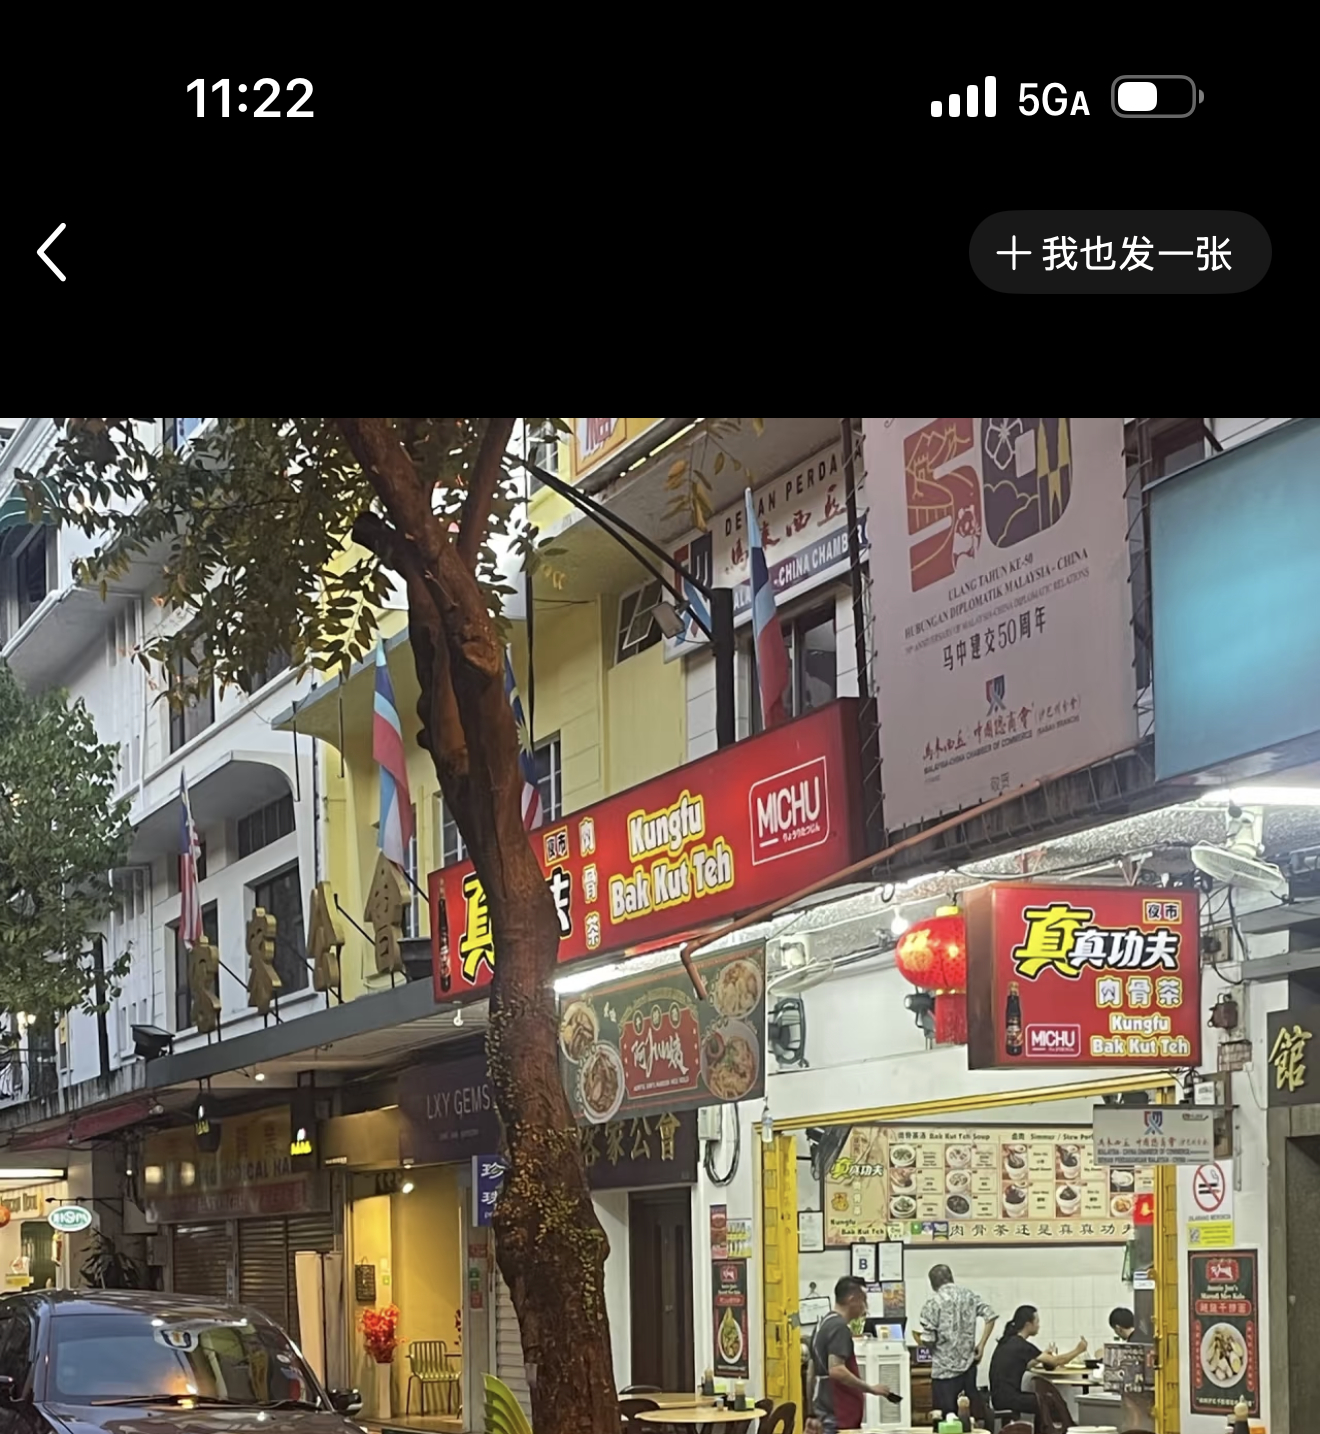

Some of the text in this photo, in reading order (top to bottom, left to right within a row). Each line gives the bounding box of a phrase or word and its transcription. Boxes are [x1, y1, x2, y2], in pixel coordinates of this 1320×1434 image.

[725, 439, 863, 537] DEAN PERDAA
[904, 611, 949, 640] HUBUNGAN
[950, 586, 1003, 620] DIPLOMATIK
[1004, 568, 1050, 597] MALAYSIA
[1057, 548, 1088, 571] CHINA
[948, 552, 1034, 602] ULANG TAHUN KE-50
[942, 606, 1046, 671] 马中建交50周年
[631, 796, 703, 856] Kungfu
[756, 776, 821, 838] MICHU
[579, 819, 601, 949] 肉骨茶
[611, 840, 733, 921] Bak Kut Teh
[1146, 903, 1179, 921] 夜市
[1096, 977, 1182, 1007] 肉骨茶
[1031, 1029, 1076, 1047] MICHU
[1092, 1036, 1191, 1055] Bak Kut Teh
[1111, 1014, 1170, 1035] Kungfu
[1267, 1025, 1312, 1092] 館
[426, 1083, 491, 1120] LXY GEMS
[973, 1133, 990, 1141] Soup
[859, 1259, 868, 1270] B
